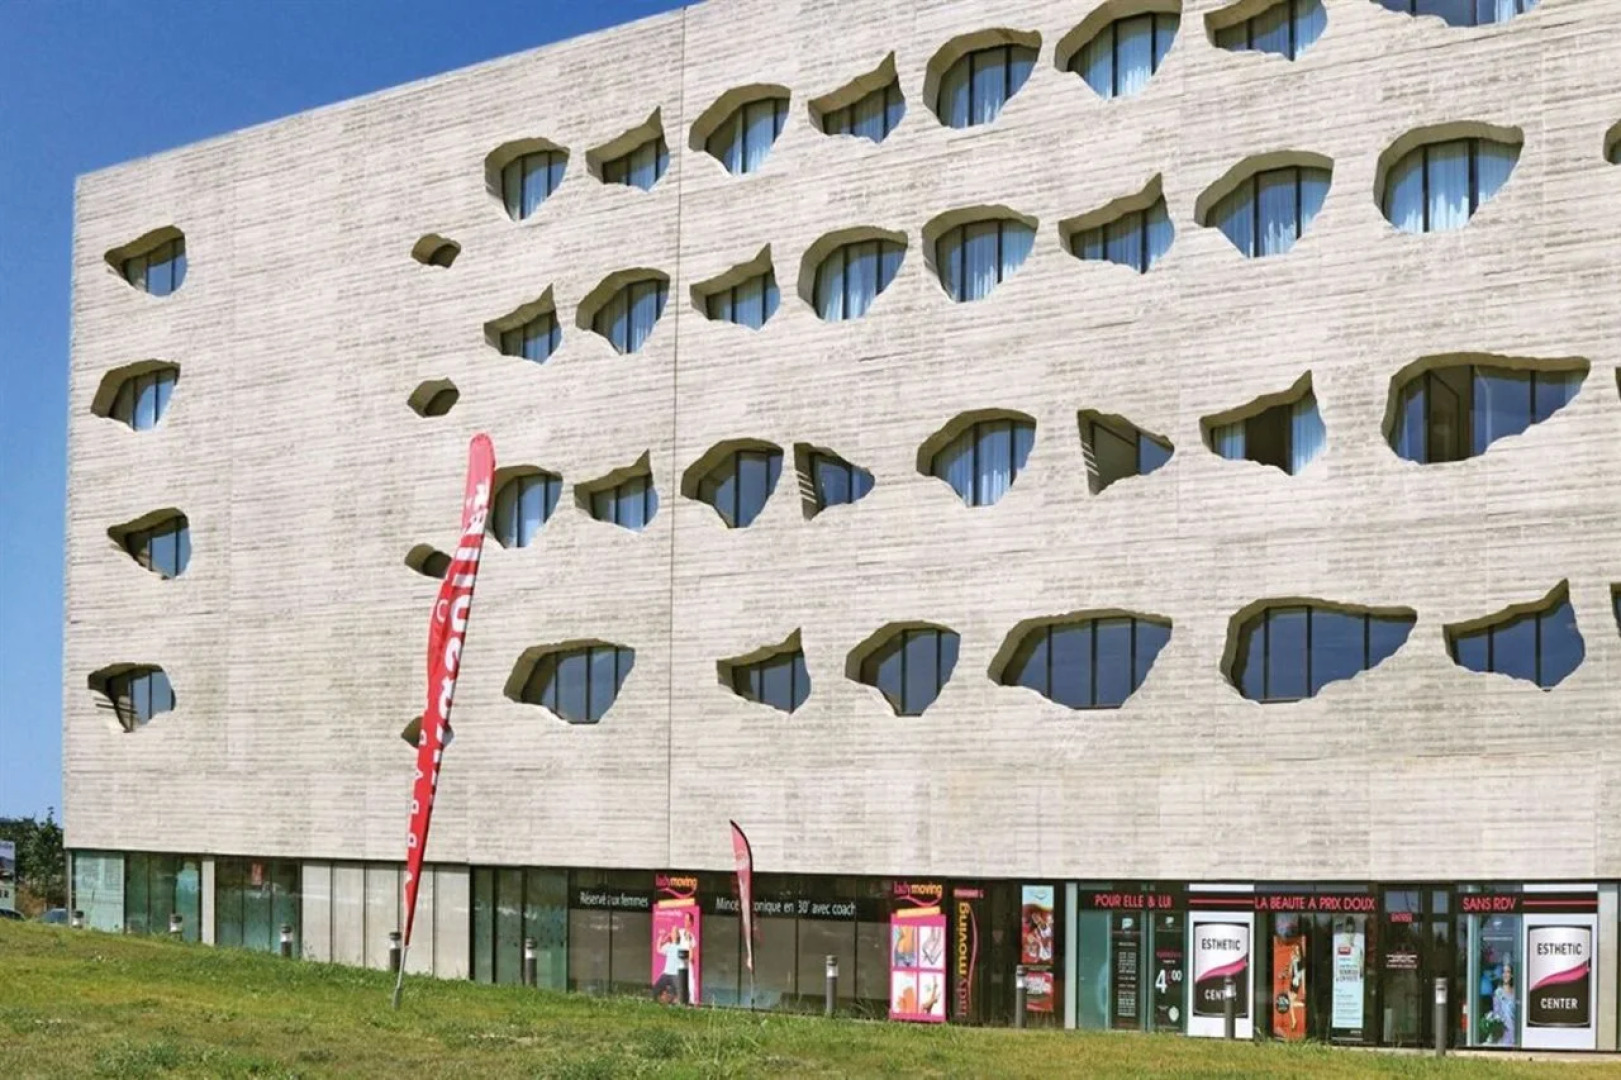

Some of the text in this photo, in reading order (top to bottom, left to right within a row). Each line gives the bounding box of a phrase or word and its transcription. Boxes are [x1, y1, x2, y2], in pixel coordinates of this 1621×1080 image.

[621, 892, 648, 908] femmes
[752, 898, 781, 914] onique
[783, 902, 795, 913] en
[812, 902, 830, 914] avec
[1094, 894, 1121, 907] POUR
[1123, 894, 1144, 908] ELLE
[1158, 895, 1172, 909] LUI
[1254, 896, 1375, 911] LA BEAUTE A PRIX DOUX
[1463, 897, 1516, 911] SANS RDV
[1201, 938, 1241, 951] ESTHETIC
[1537, 942, 1583, 955] ESTHETIC
[1540, 998, 1579, 1009] CENTER
